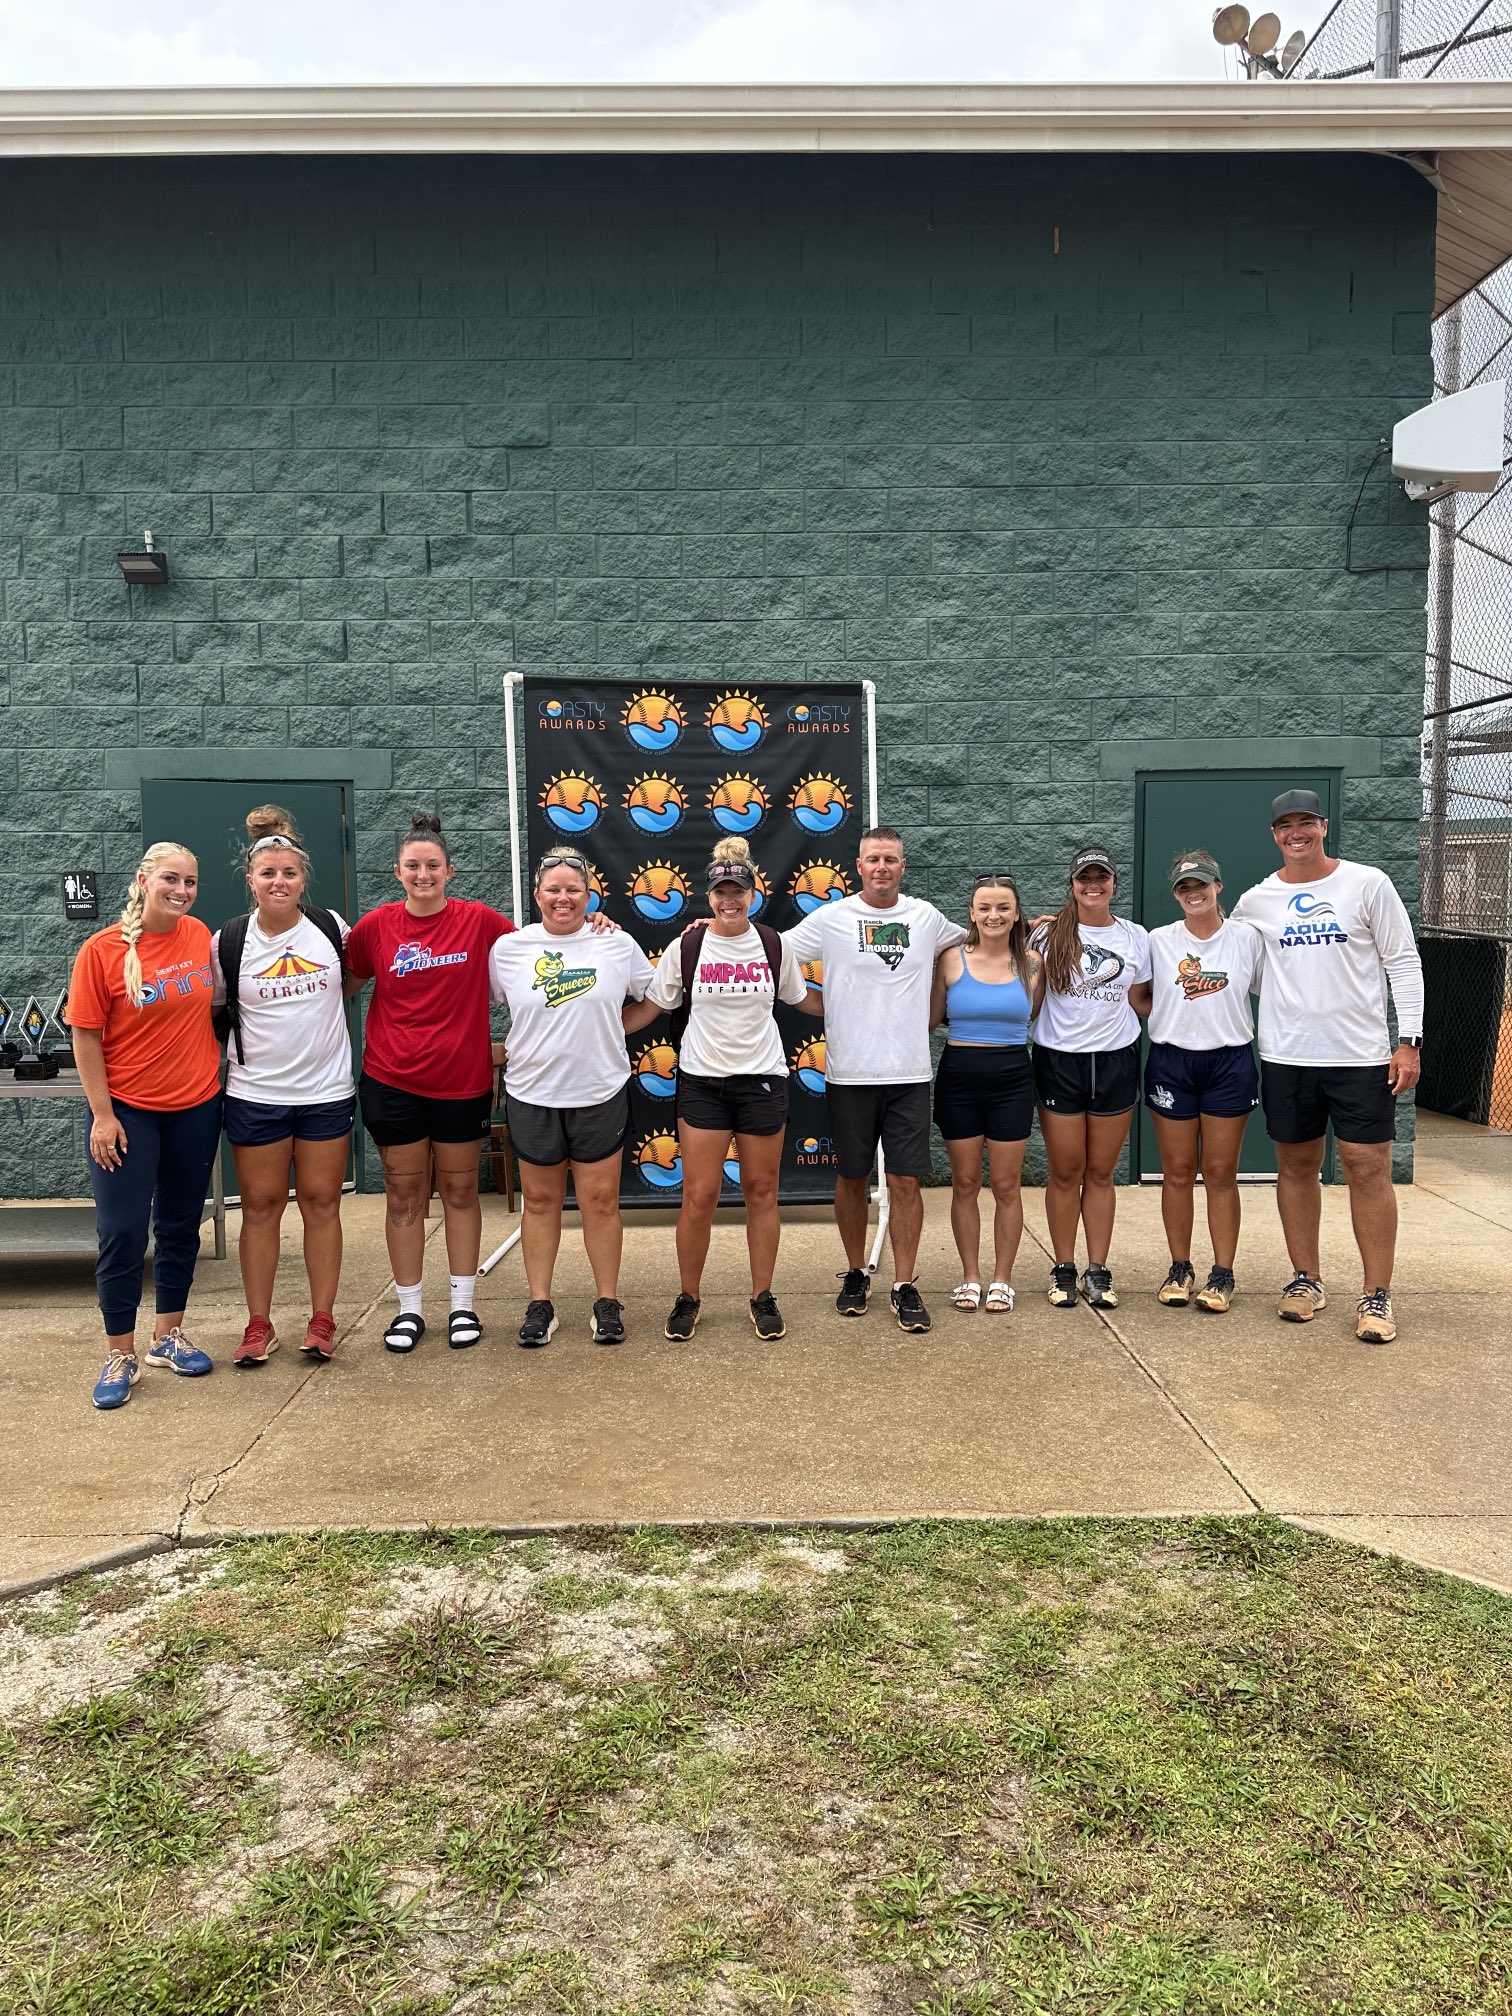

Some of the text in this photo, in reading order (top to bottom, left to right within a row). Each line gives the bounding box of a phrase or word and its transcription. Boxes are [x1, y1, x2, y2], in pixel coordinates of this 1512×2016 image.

[539, 718, 606, 731] AWARDS
[787, 723, 850, 734] AWARDS
[857, 920, 865, 953] Lakewood
[1283, 922, 1343, 936] AQUA
[865, 944, 904, 953] RODEO
[1279, 933, 1348, 949] NAUTS
[179, 960, 193, 969] KEY
[396, 951, 468, 977] PIONEERS
[256, 971, 329, 985] SARASOTA
[700, 962, 770, 983] IMPACT
[259, 979, 328, 999] CIRCUS
[545, 975, 595, 998] Squeeze
[1112, 983, 1127, 991] CITY
[1183, 976, 1226, 993] Slice
[796, 1137, 835, 1153] COA
[797, 1154, 838, 1165] AWAR
